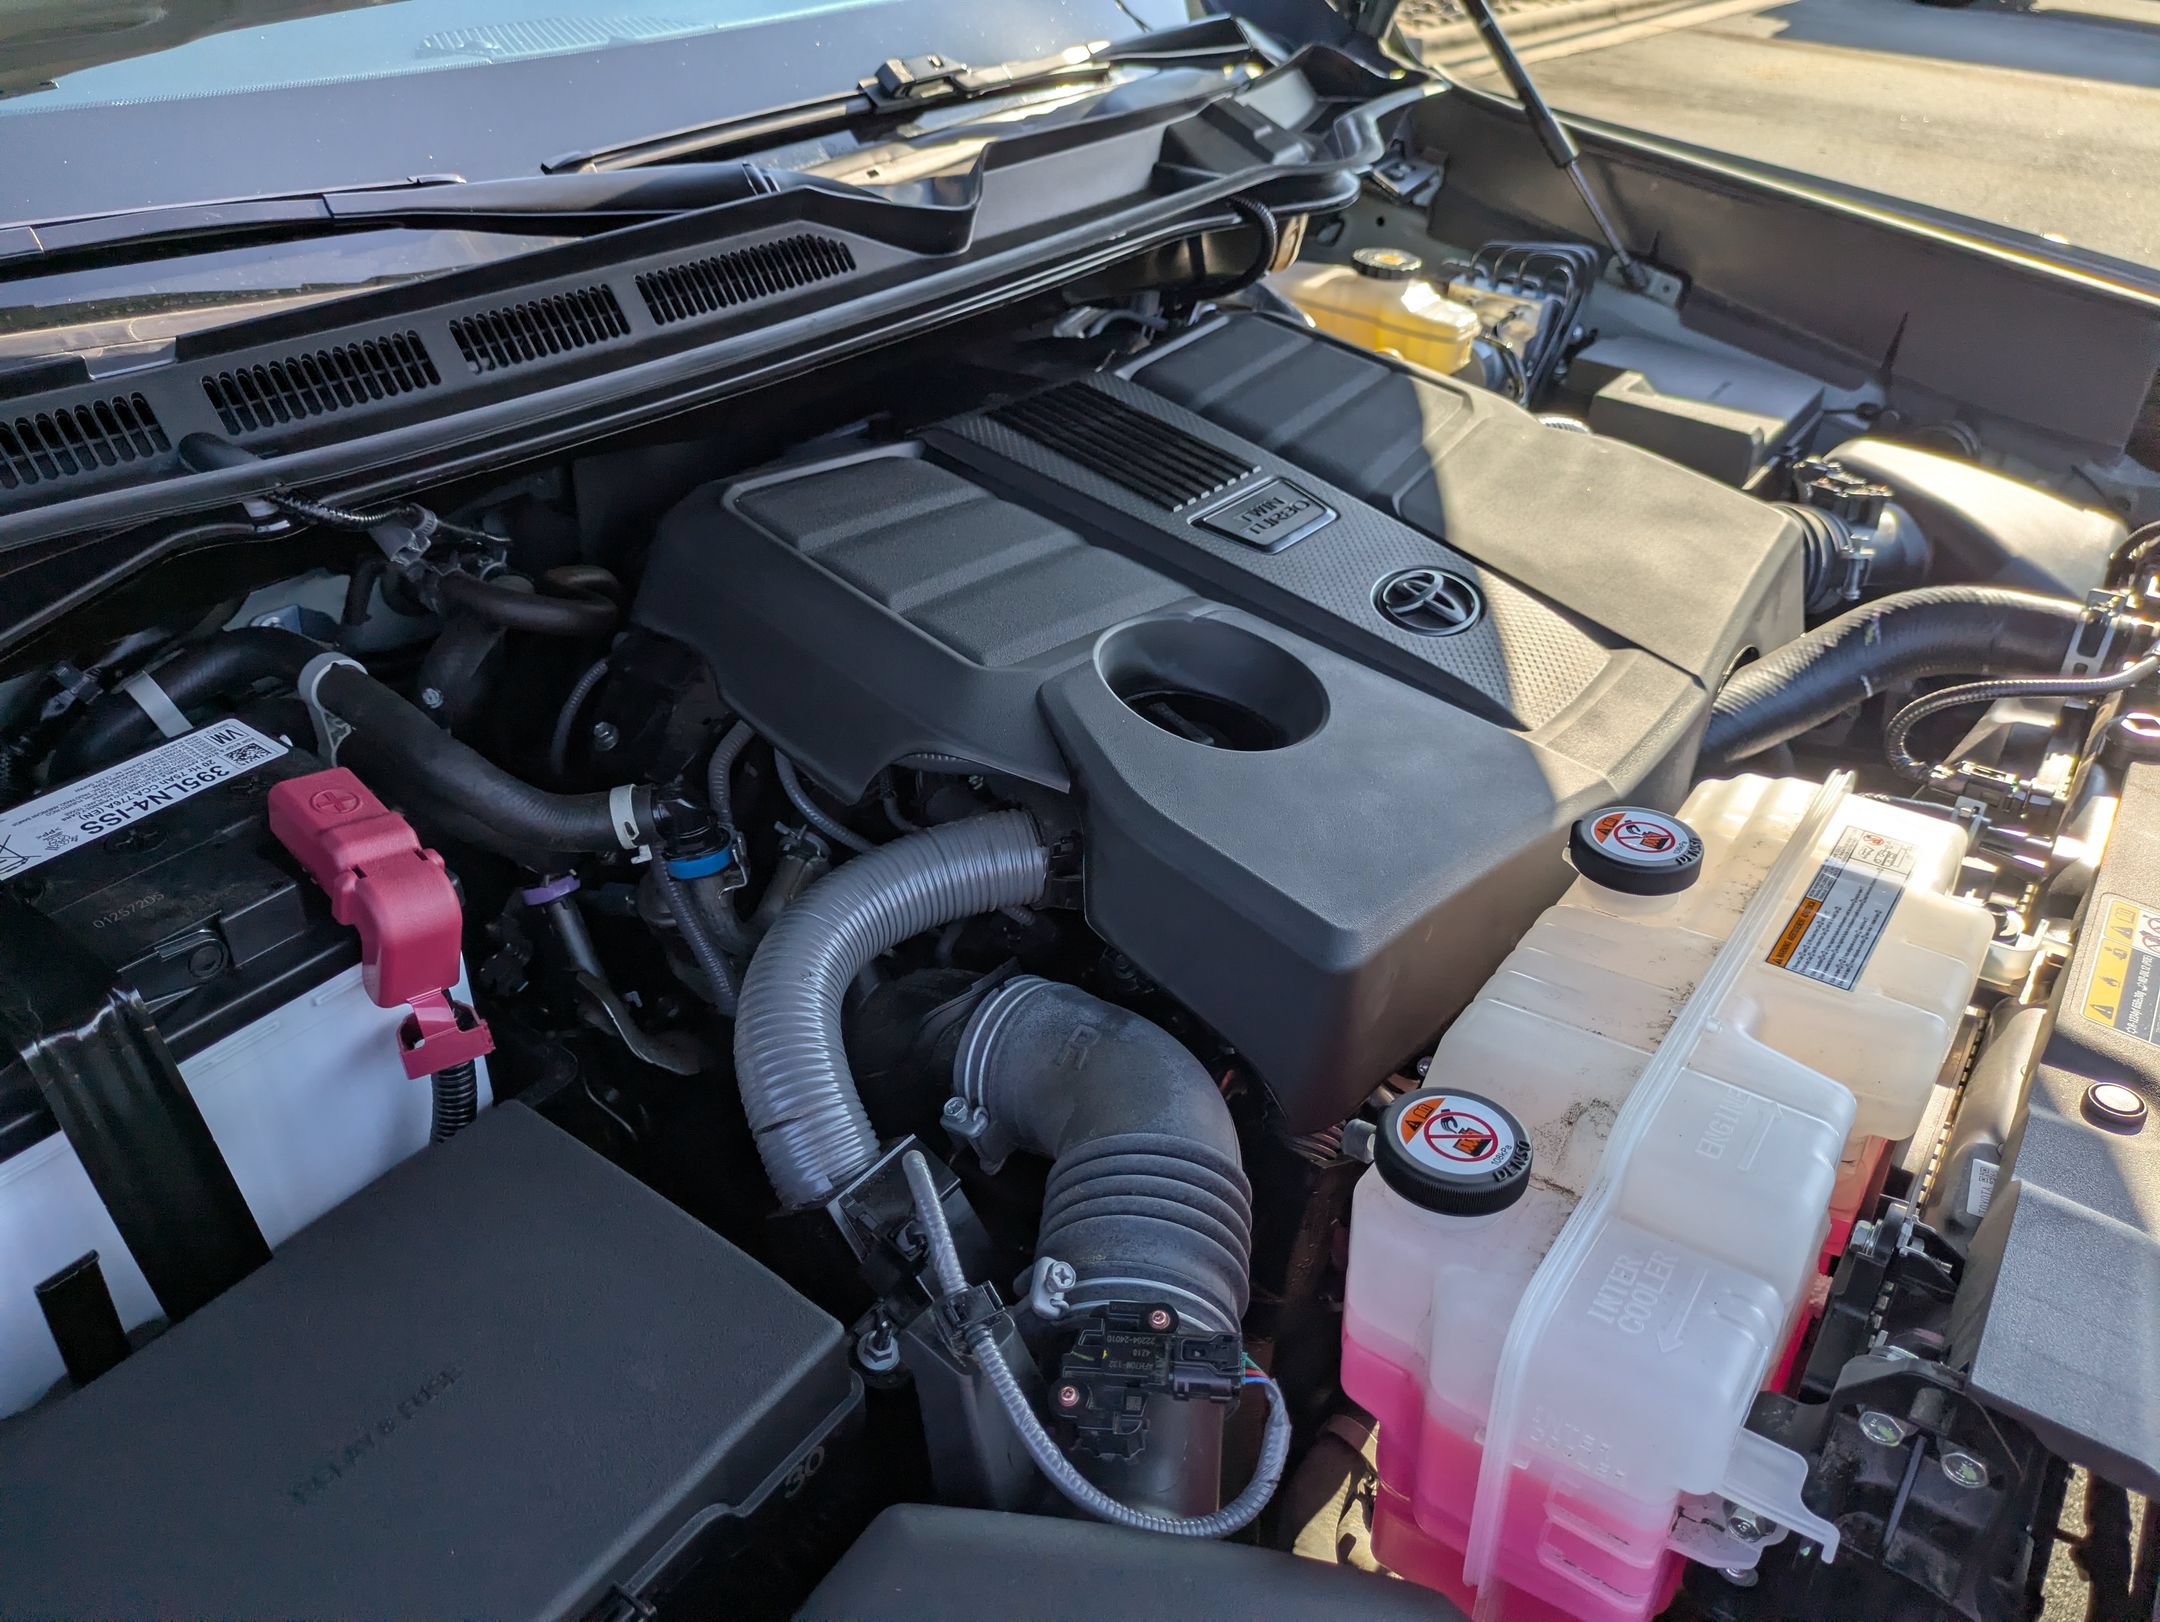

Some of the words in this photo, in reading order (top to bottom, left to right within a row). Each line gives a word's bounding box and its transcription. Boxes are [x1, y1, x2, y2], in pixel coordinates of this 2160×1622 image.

[1234, 497, 1285, 522] TWIN
[1241, 500, 1310, 534] TURBO
[208, 727, 244, 744] VM
[185, 764, 203, 773] Hr
[198, 758, 217, 767] 20
[131, 783, 160, 797] CCA
[157, 771, 188, 785] 75Ah
[81, 766, 229, 835] 395LN4-ISS
[103, 794, 135, 809] 776A
[75, 806, 107, 821] (EN)
[1694, 1086, 1751, 1160] ENGINE
[1490, 1144, 1514, 1167] 108kPa
[1494, 1139, 1532, 1184] DENSO
[1586, 1254, 1644, 1325] INTER
[1617, 1249, 1680, 1335] COOLER
[397, 1363, 463, 1422] FUSE
[784, 1446, 825, 1499] 30
